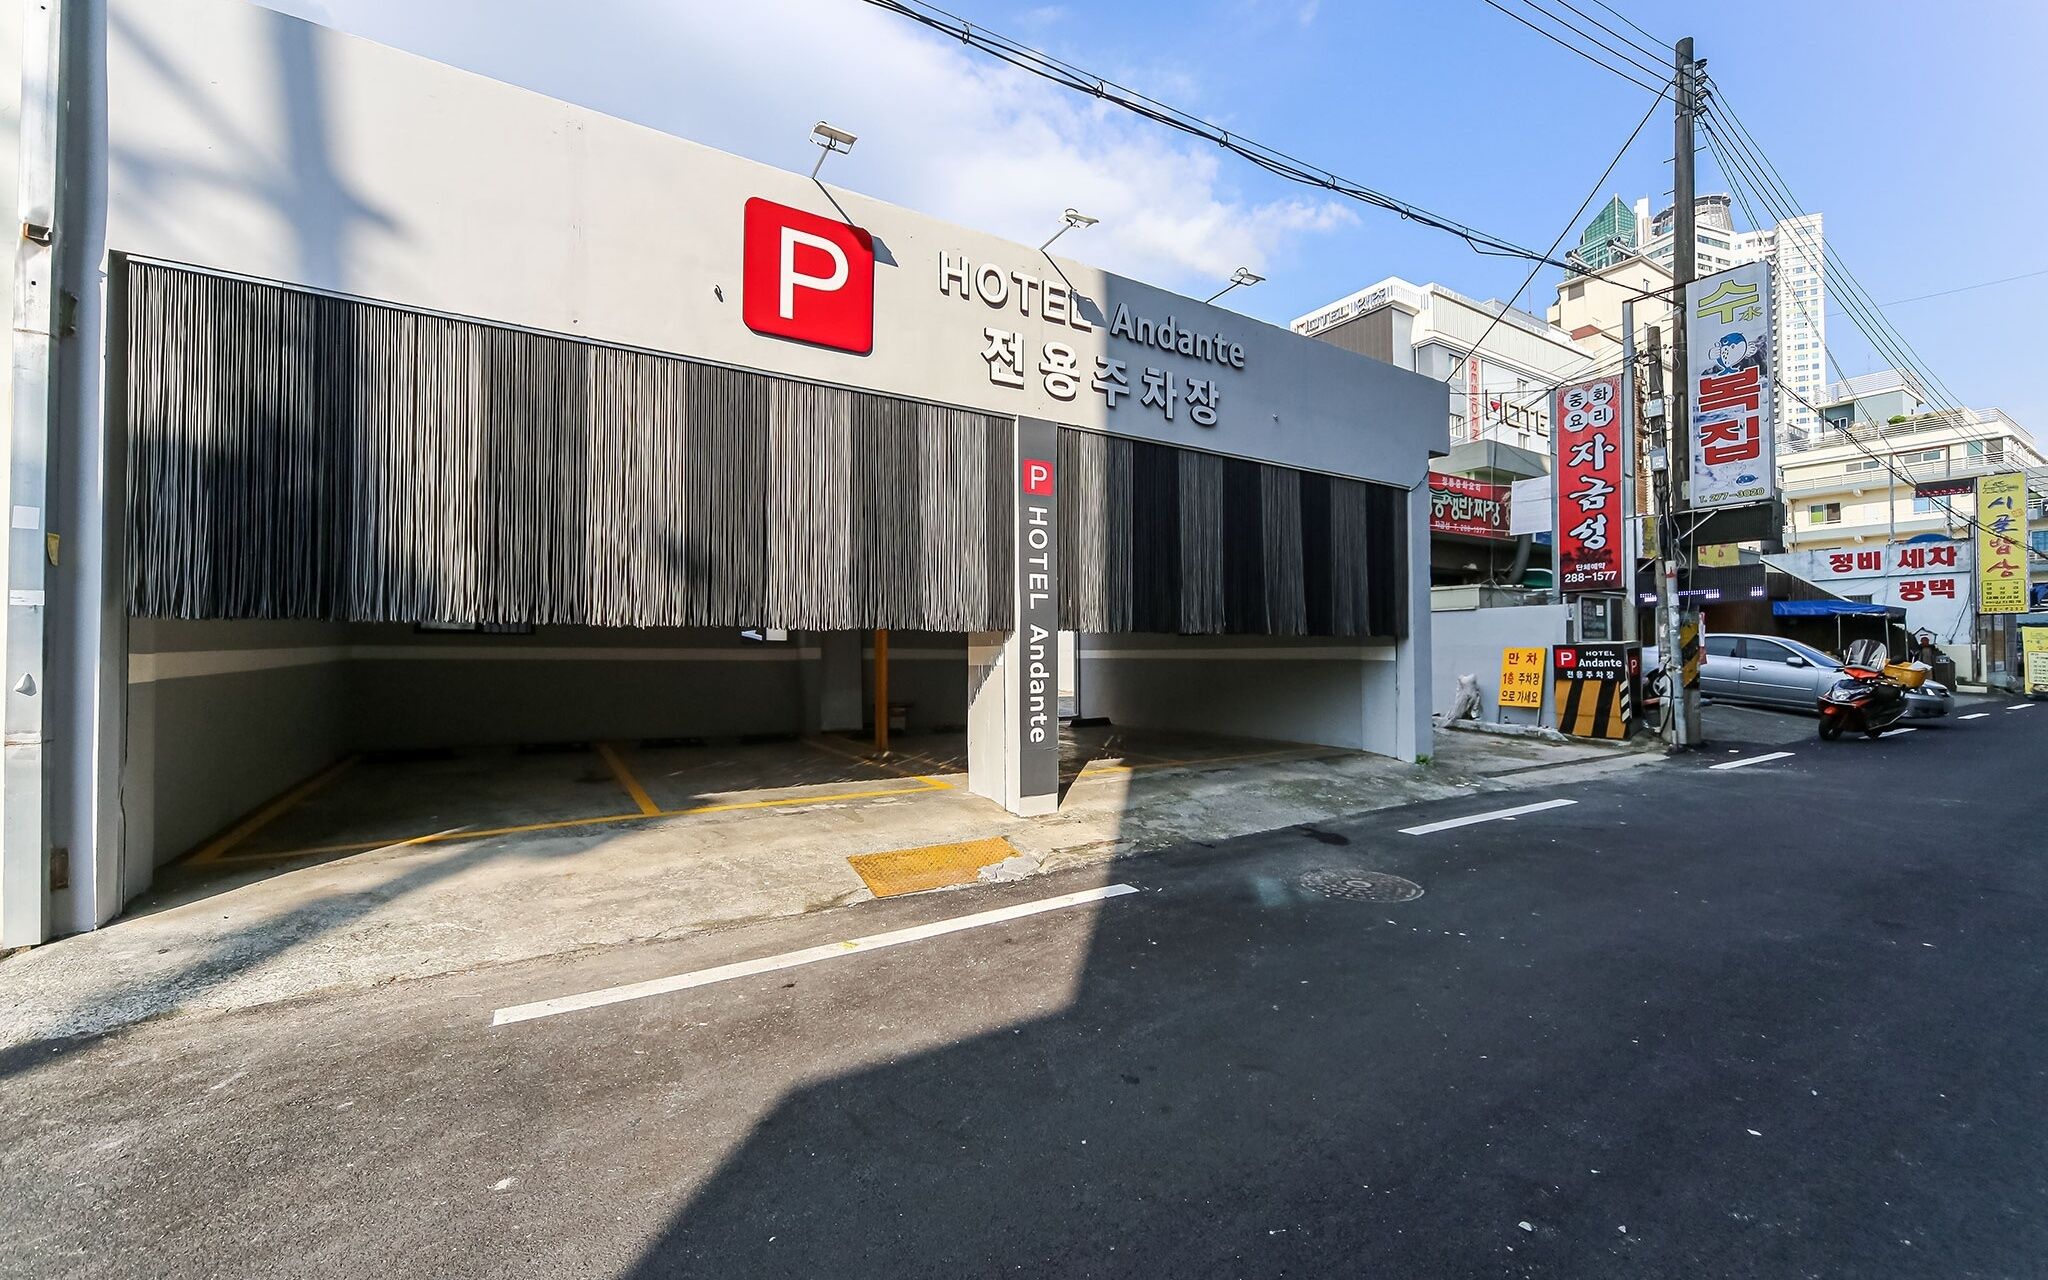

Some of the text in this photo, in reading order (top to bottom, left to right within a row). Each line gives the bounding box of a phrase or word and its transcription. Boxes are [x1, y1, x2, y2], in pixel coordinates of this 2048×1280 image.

[779, 225, 849, 320] P
[939, 249, 1246, 369] HOTEL Andante
[1696, 279, 1760, 325] 수
[980, 327, 1221, 426] 전용주차장
[1698, 366, 1761, 466] 복집
[1032, 465, 1048, 490] P
[1568, 432, 1615, 550] 자금성
[1709, 488, 1765, 502] 277-3020
[1576, 562, 1606, 572] 단체예약
[1829, 546, 1958, 573] 정비 세차
[1565, 570, 1617, 583] 288-1577
[1899, 578, 1955, 601] 광택
[1028, 506, 1049, 744] HOTEL Andante
[1560, 651, 1622, 668] P Andante
[1503, 672, 1540, 686] 1층 주차장
